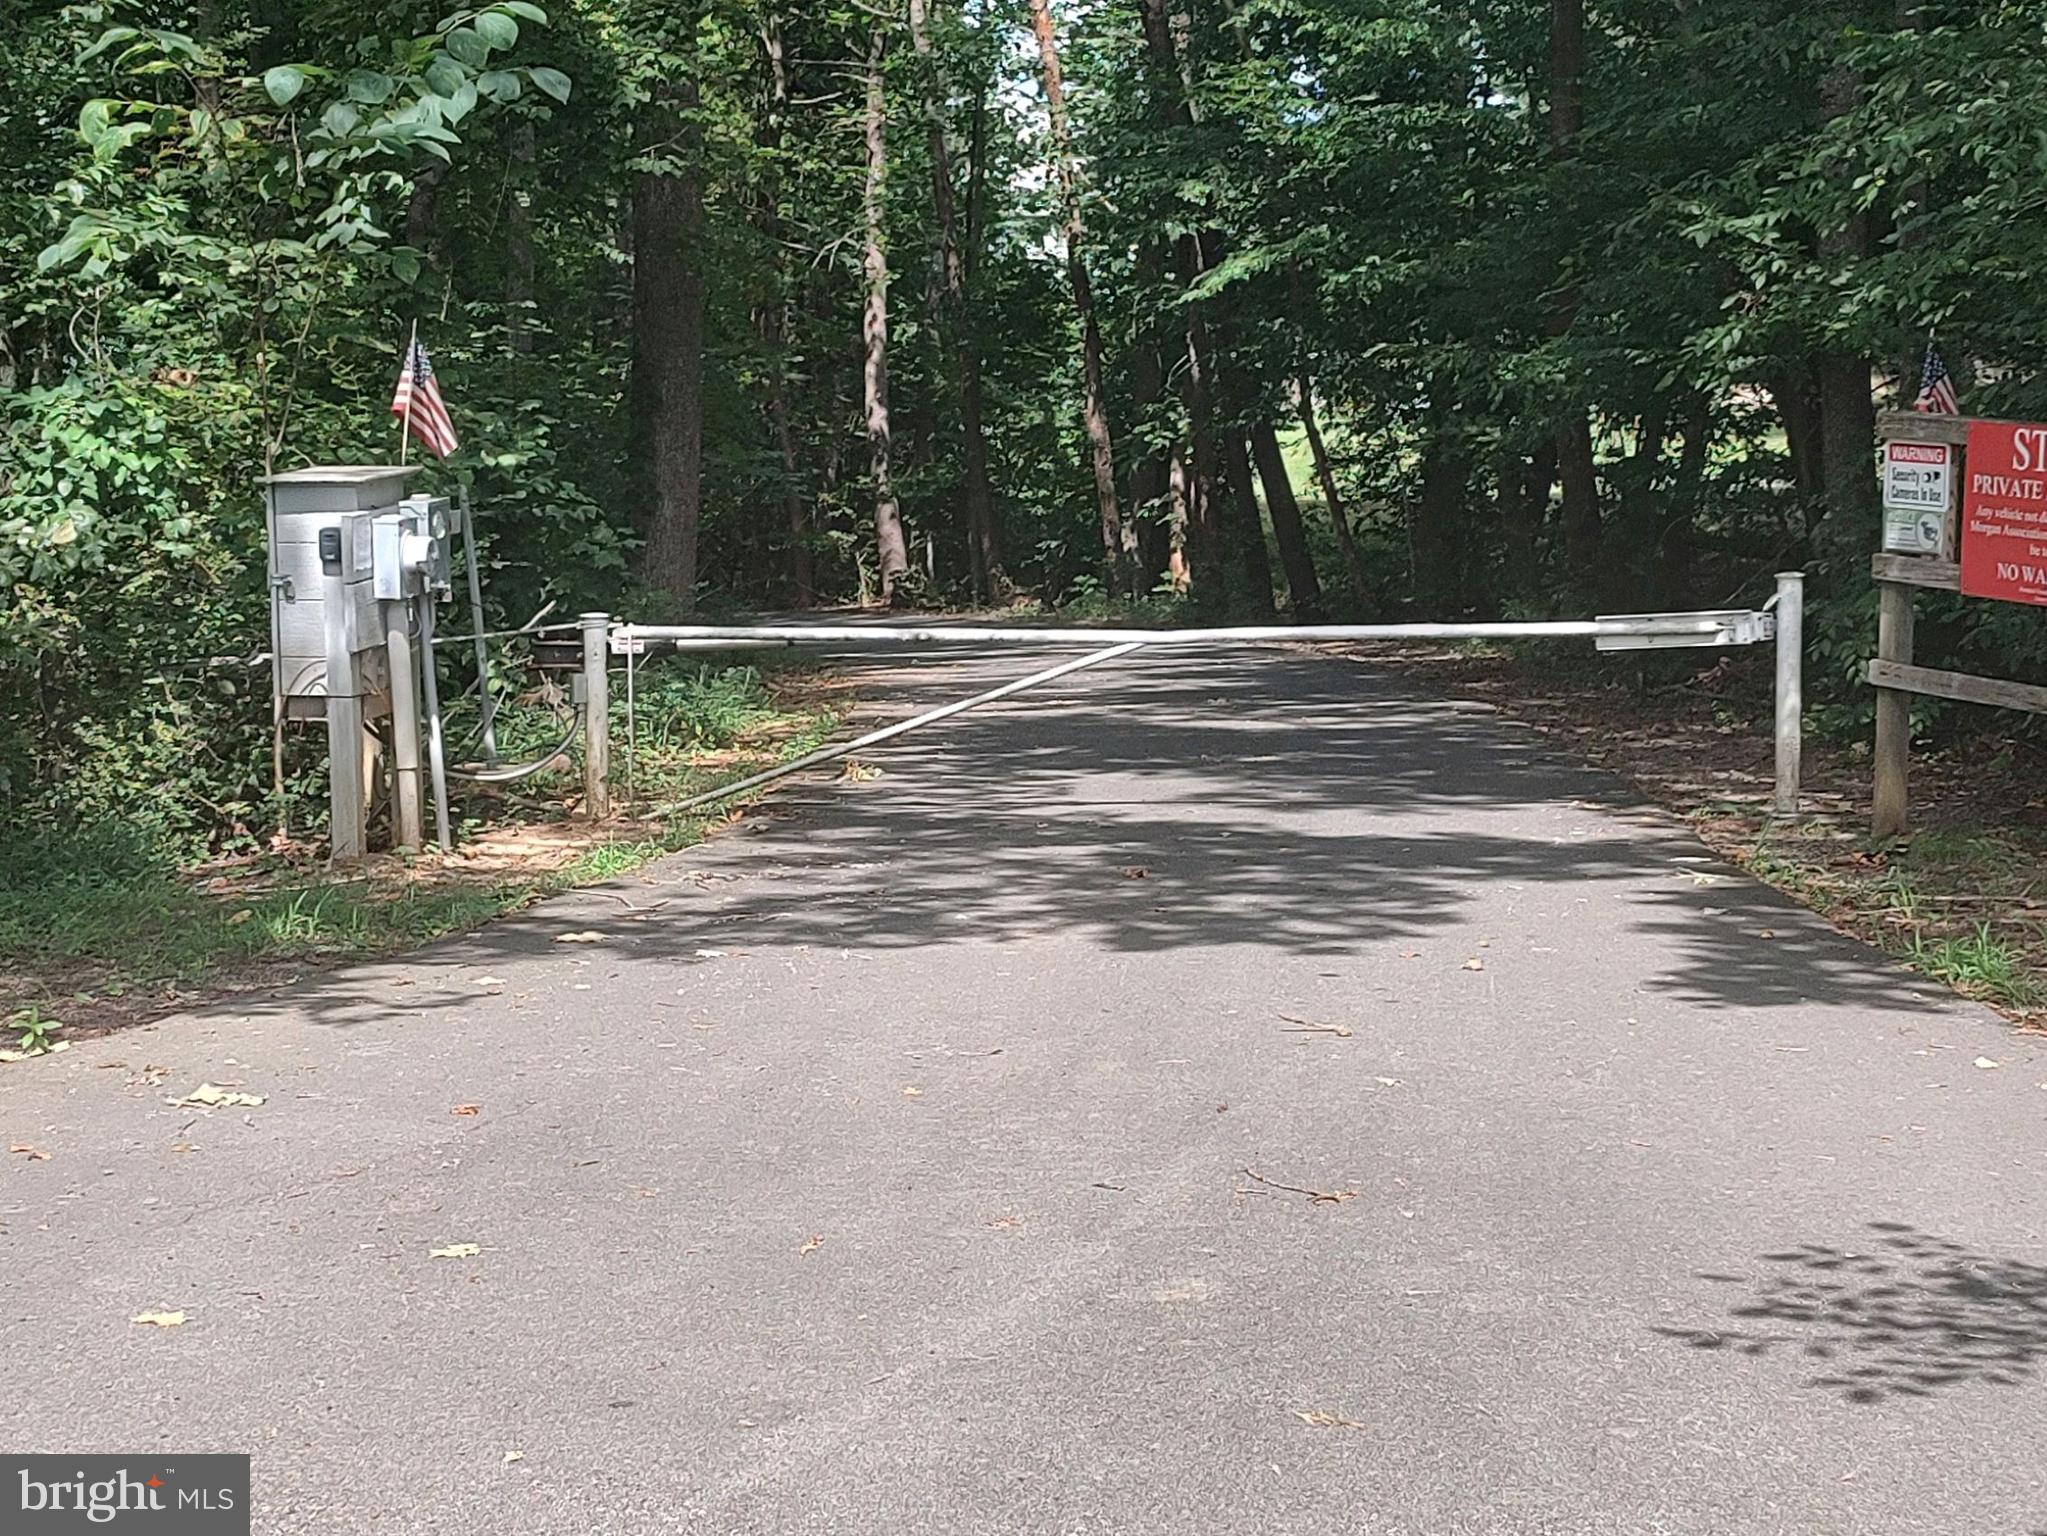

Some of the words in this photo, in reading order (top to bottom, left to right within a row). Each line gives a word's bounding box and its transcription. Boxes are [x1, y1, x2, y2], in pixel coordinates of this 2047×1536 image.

[1891, 446, 1944, 463] WARNING
[1892, 466, 1919, 487] Security
[1892, 484, 1919, 500] Cameras
[1972, 474, 2043, 499] PRIVATE
[1975, 504, 1993, 520] Any
[1995, 507, 2023, 520] vehicle
[2024, 512, 2038, 523] not
[1970, 520, 2001, 536] Morgan
[2029, 543, 2041, 556] be
[1997, 562, 2018, 581] NO
